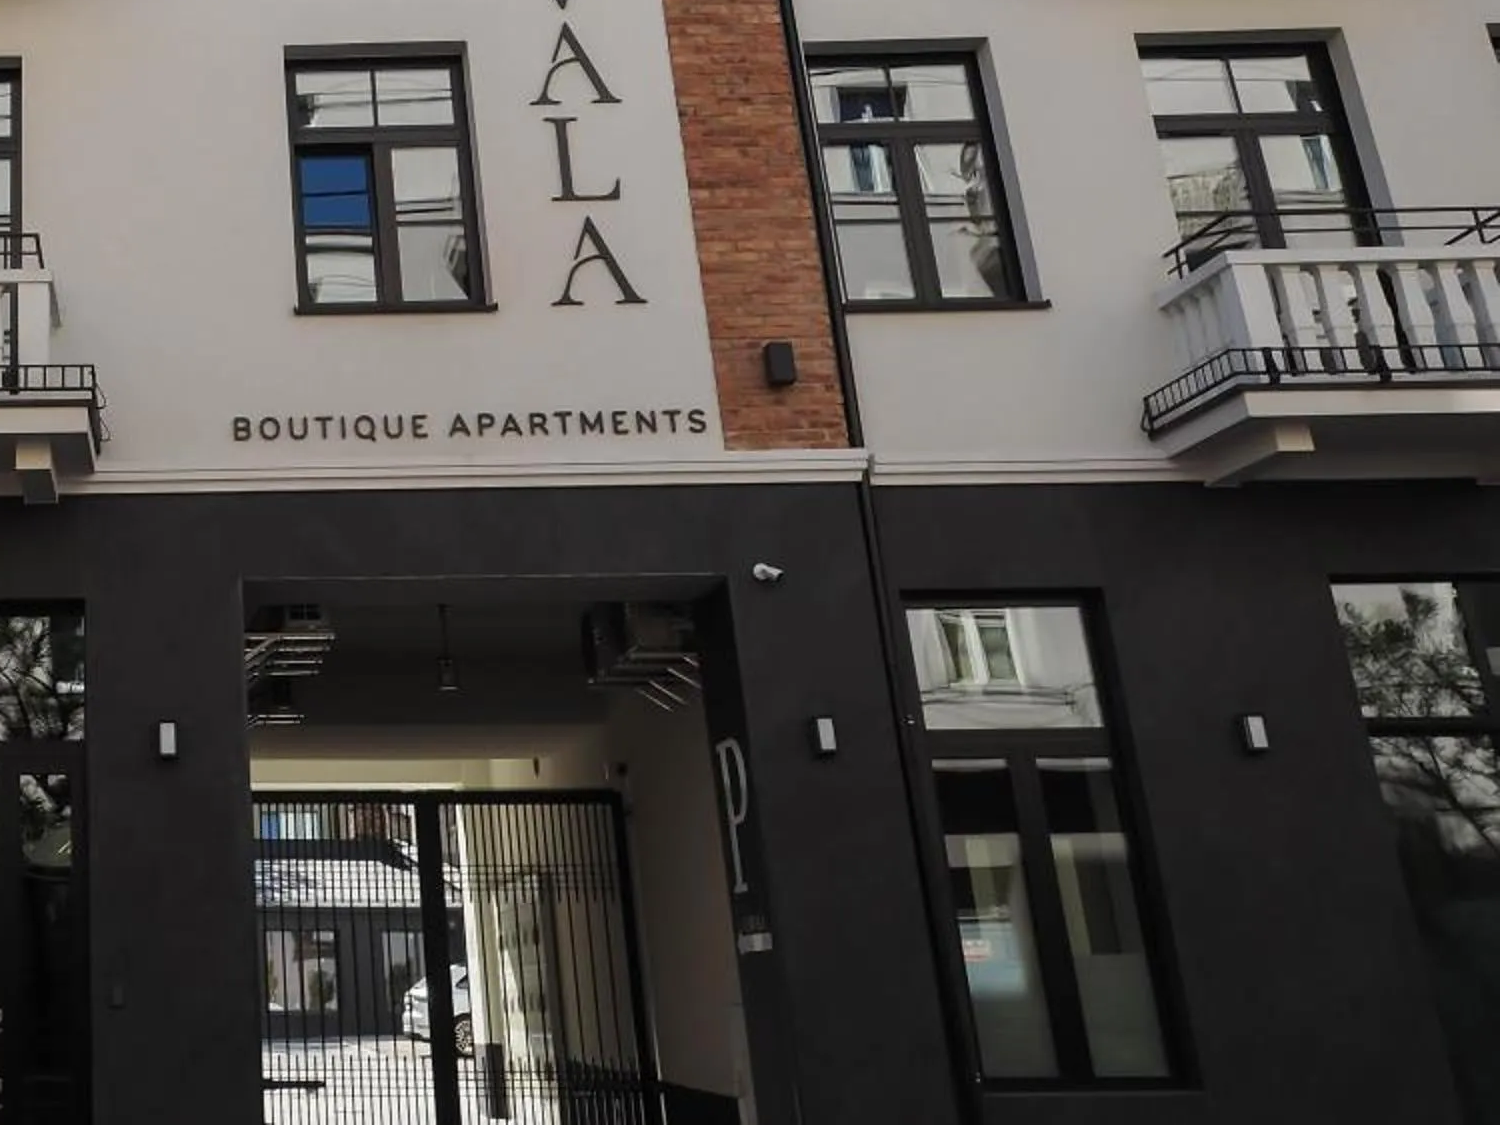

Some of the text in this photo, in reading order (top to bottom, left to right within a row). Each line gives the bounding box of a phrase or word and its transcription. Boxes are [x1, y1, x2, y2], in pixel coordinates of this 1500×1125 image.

[232, 408, 707, 443] BOUTIQUE APARTMENTS
[715, 736, 749, 894] P
